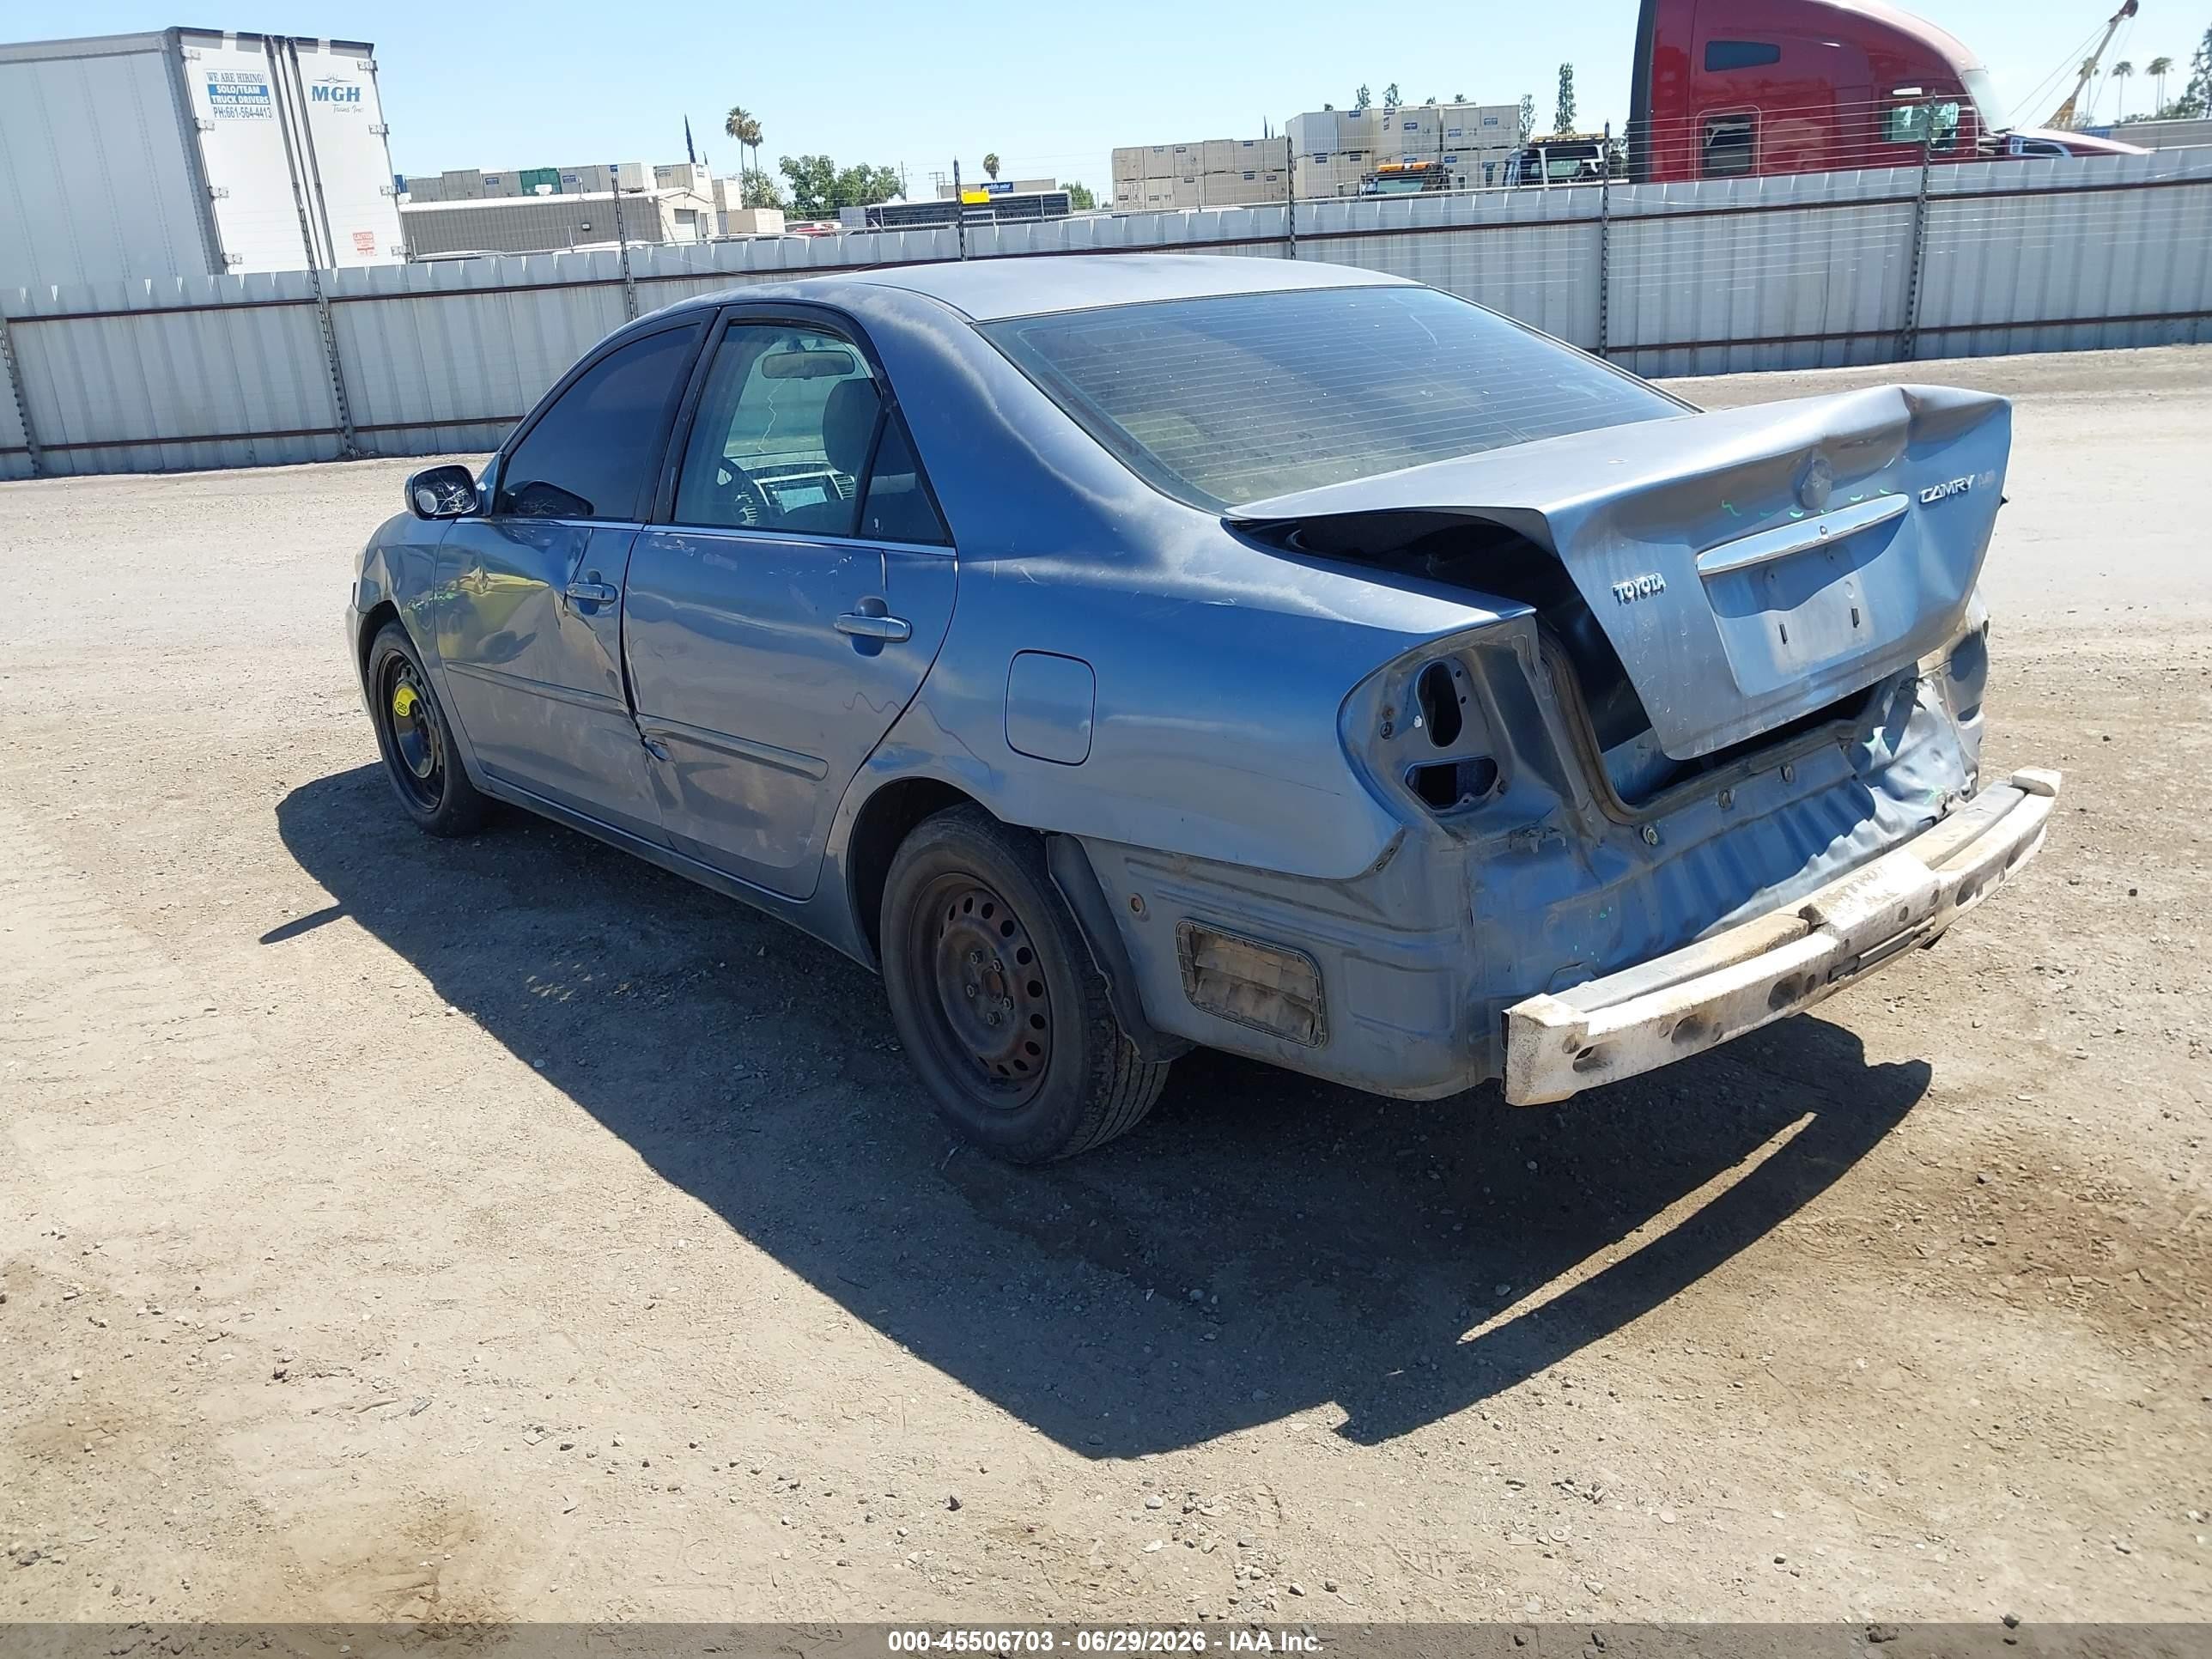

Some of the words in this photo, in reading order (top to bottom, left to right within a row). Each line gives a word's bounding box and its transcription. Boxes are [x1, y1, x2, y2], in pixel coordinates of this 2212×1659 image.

[206, 72, 219, 82] WE
[221, 73, 235, 82] ARE
[236, 73, 265, 83] HIRING!
[216, 86, 261, 95] SOLO/TEAM
[312, 86, 361, 102] MGH
[211, 95, 238, 104] TRUCK
[238, 95, 270, 104] DRIVERS
[1919, 474, 1975, 504] CAMRY
[1611, 572, 1667, 602] TOYOTA
